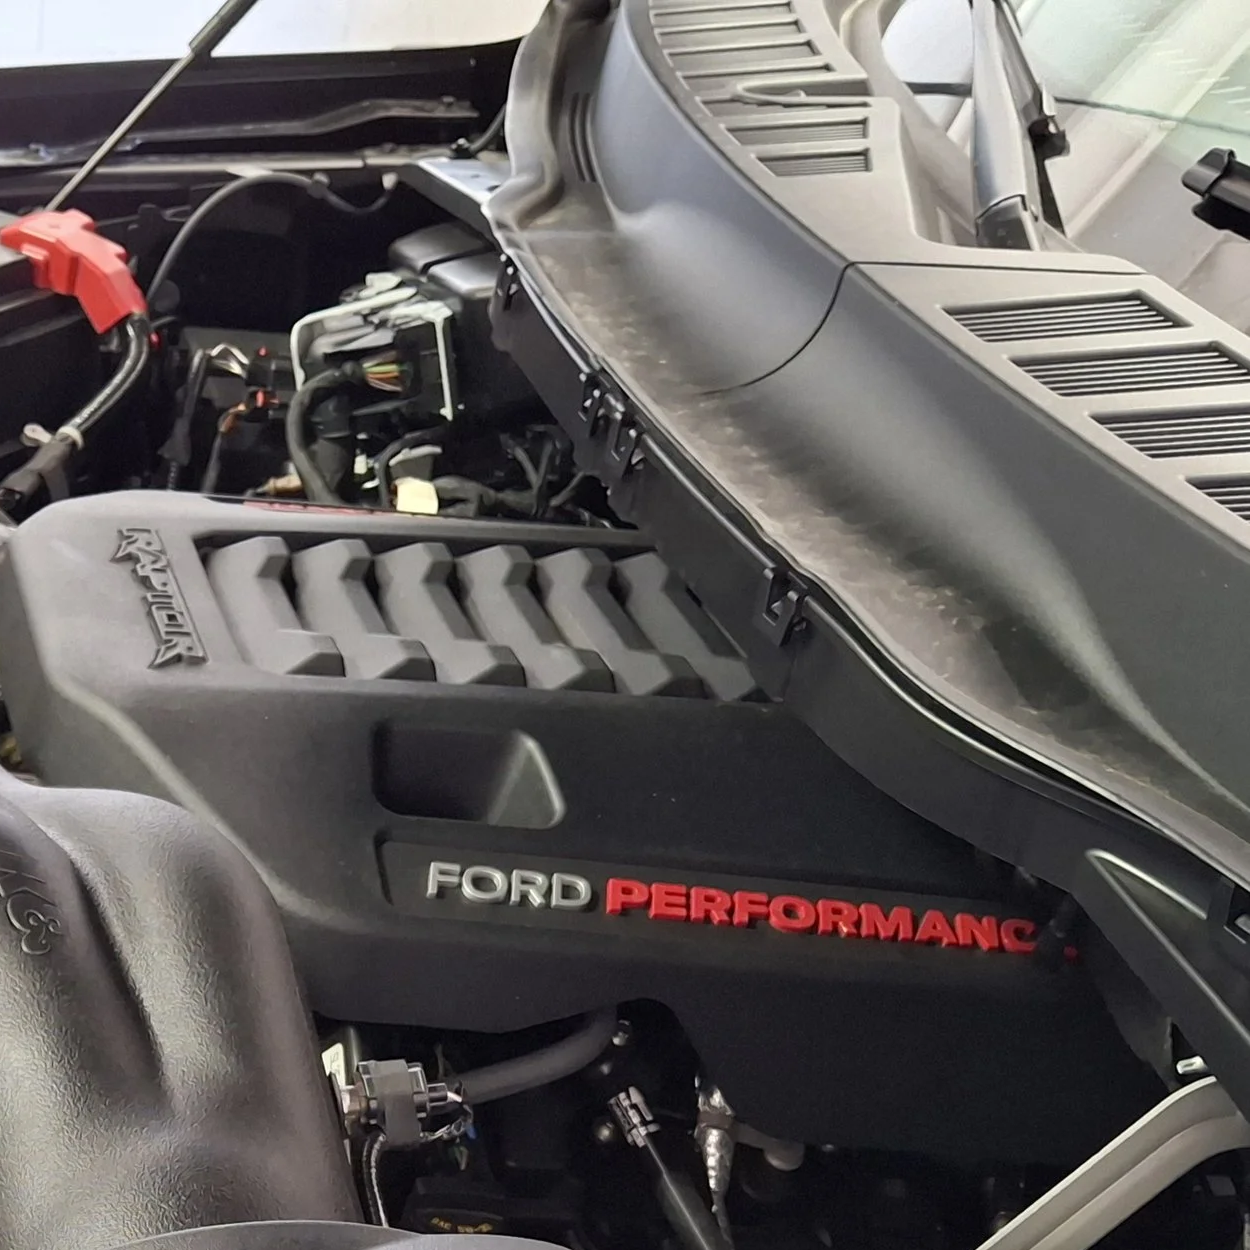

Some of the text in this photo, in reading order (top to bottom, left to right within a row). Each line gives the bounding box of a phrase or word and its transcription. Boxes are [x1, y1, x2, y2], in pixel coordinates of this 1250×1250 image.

[110, 528, 211, 670] RAPTOR
[426, 860, 1038, 955] FORD PERFORMANC
